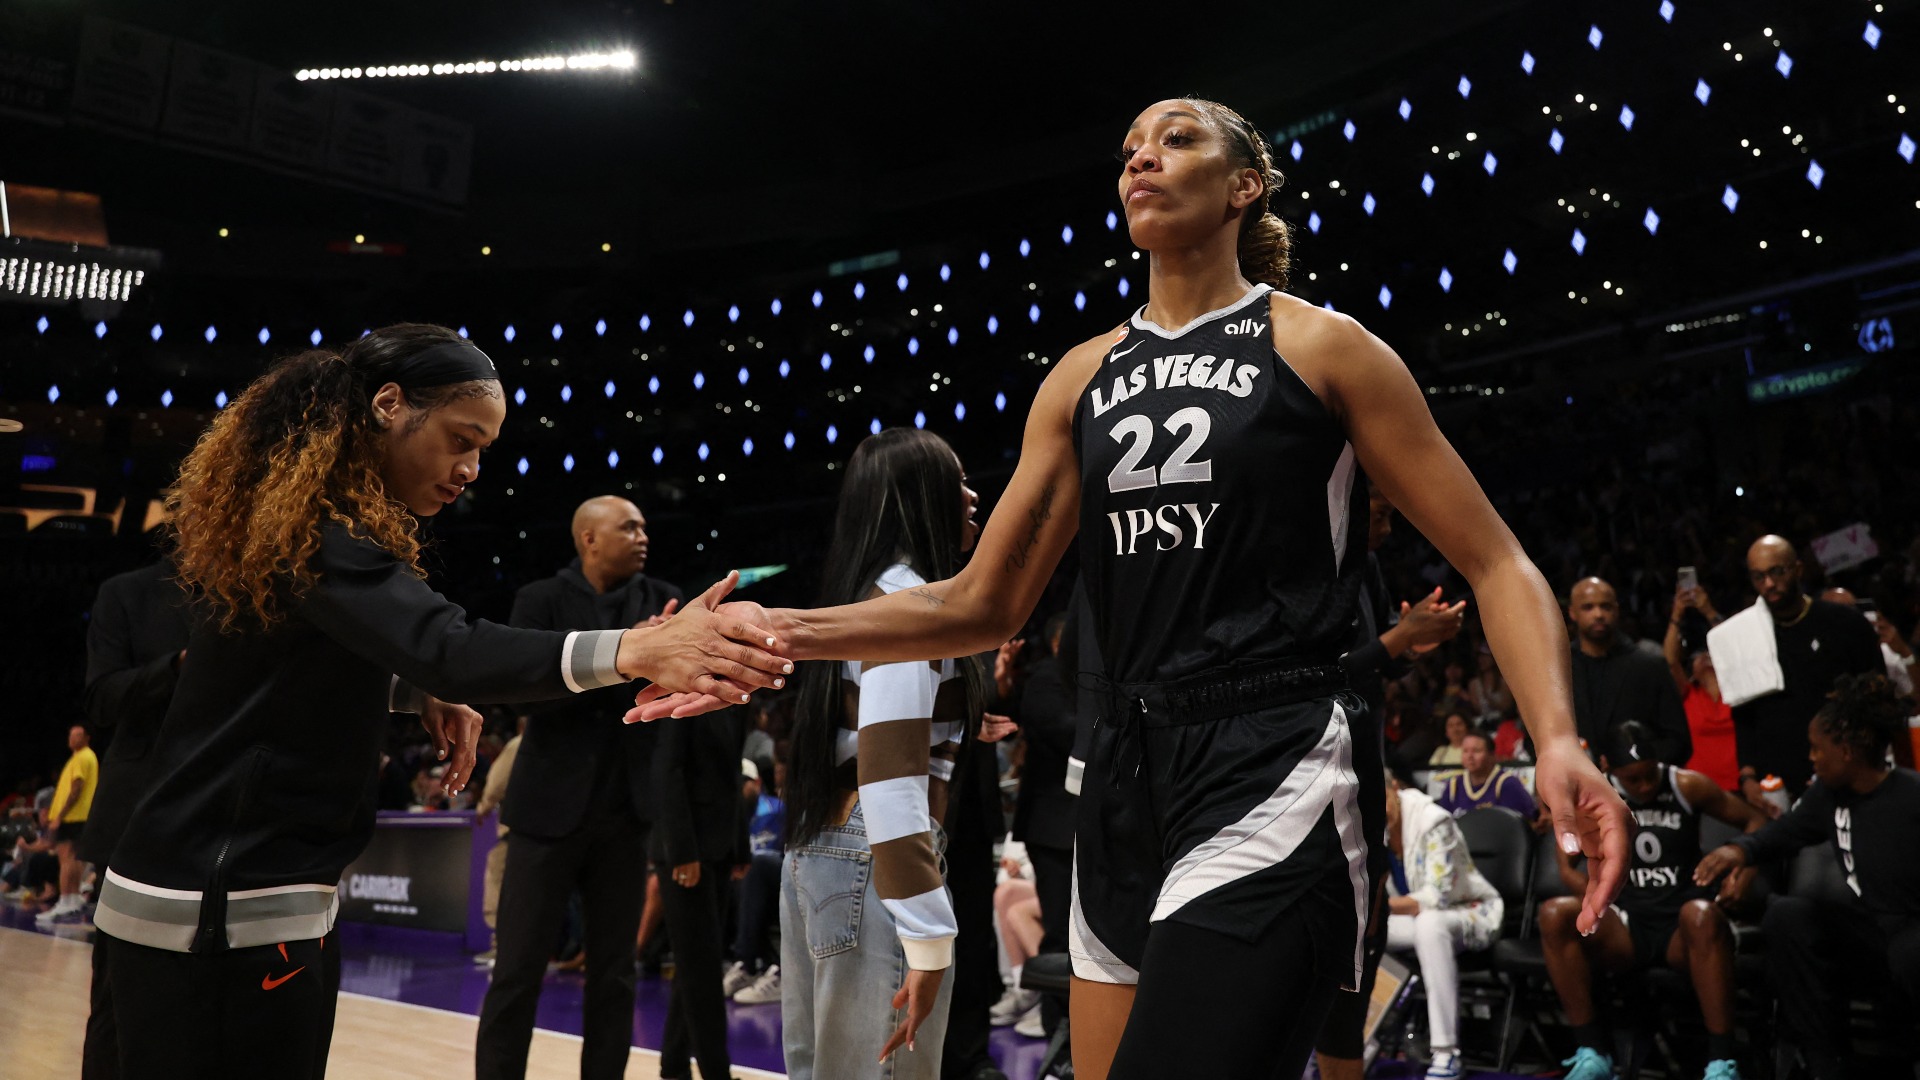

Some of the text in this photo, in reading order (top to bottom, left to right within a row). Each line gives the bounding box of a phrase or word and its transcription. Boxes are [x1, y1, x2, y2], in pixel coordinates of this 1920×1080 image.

[1224, 319, 1266, 337] ally
[1091, 354, 1260, 418] LAS VEGAS
[1108, 406, 1212, 493] 22
[1107, 502, 1221, 555] IPSY
[1635, 831, 1662, 863] 0
[1834, 805, 1863, 898] ACES
[1630, 865, 1680, 888] IPSY
